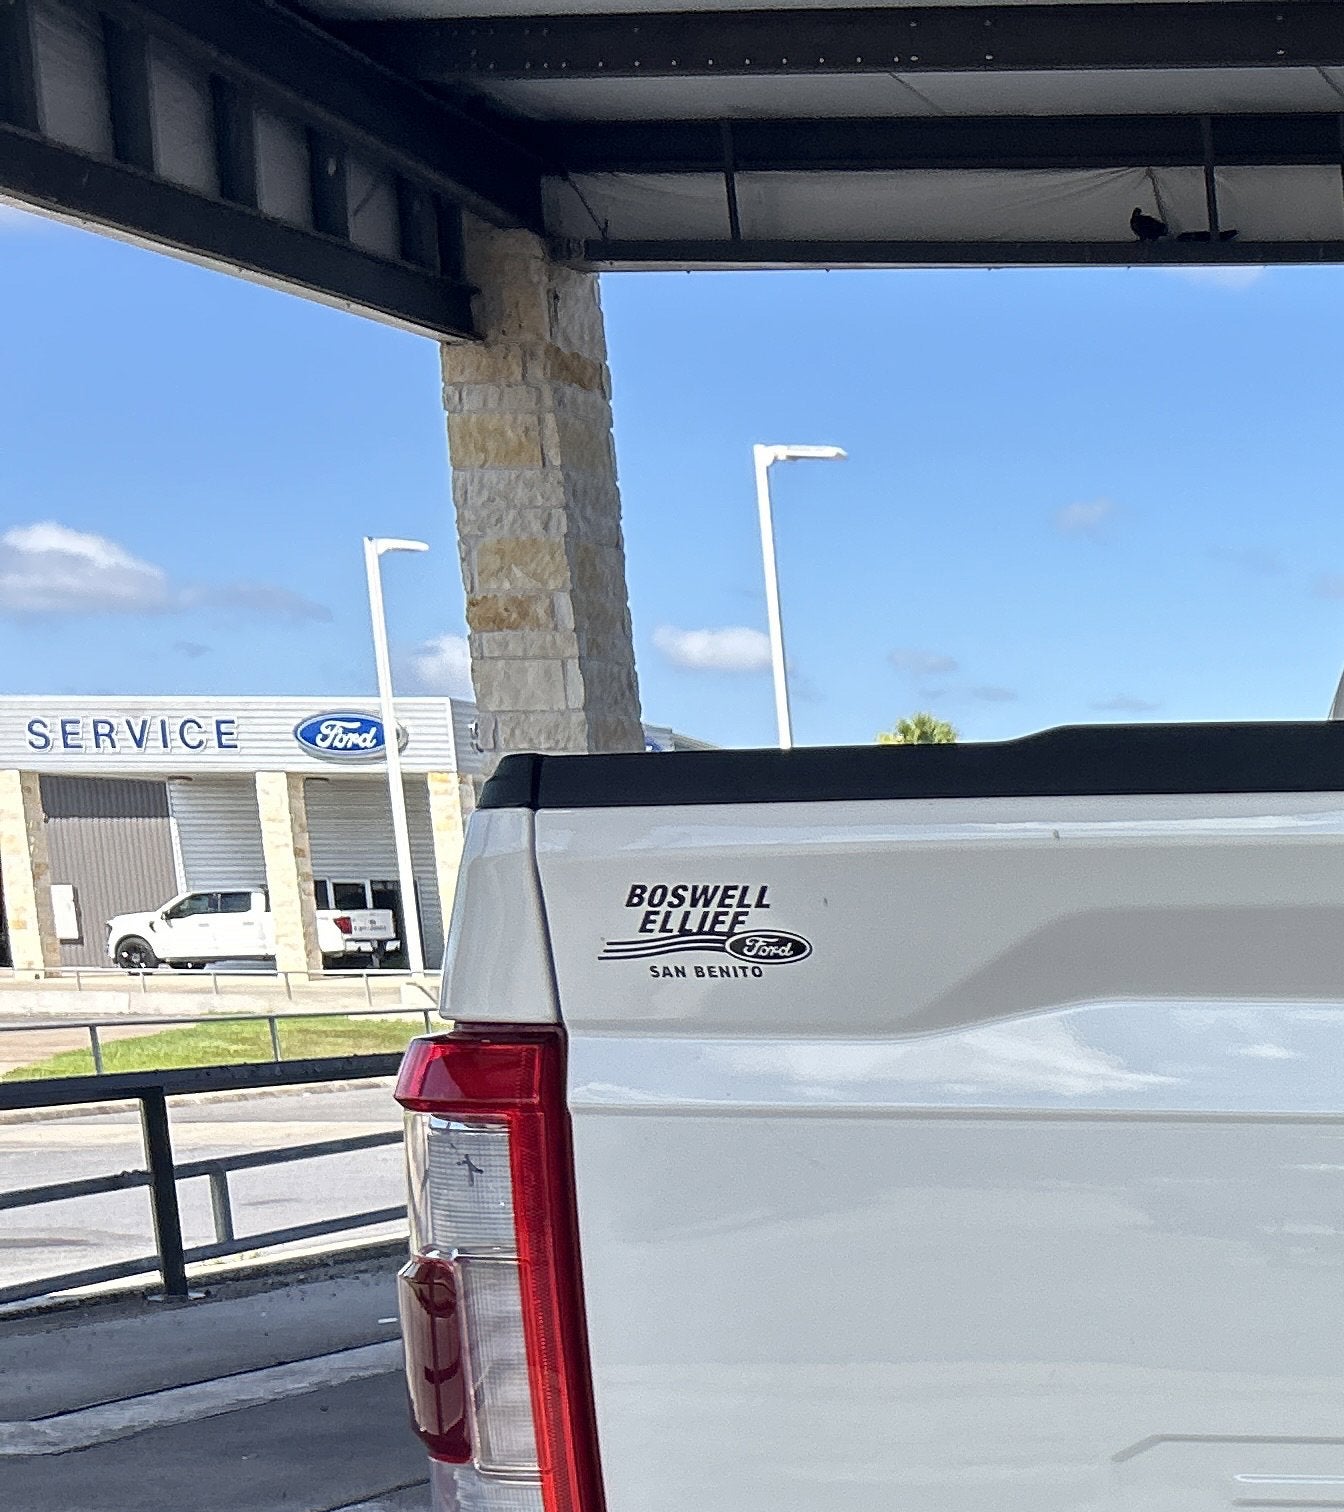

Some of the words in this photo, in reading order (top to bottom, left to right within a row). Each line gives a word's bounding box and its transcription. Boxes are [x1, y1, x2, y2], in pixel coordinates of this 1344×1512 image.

[26, 717, 239, 751] SERVICE
[314, 720, 378, 750] Ford
[624, 883, 771, 909] BOSWELL
[637, 910, 750, 934] ELLIFF
[742, 936, 794, 958] Ford
[649, 965, 687, 978] SAN
[694, 965, 763, 979] BENITO
